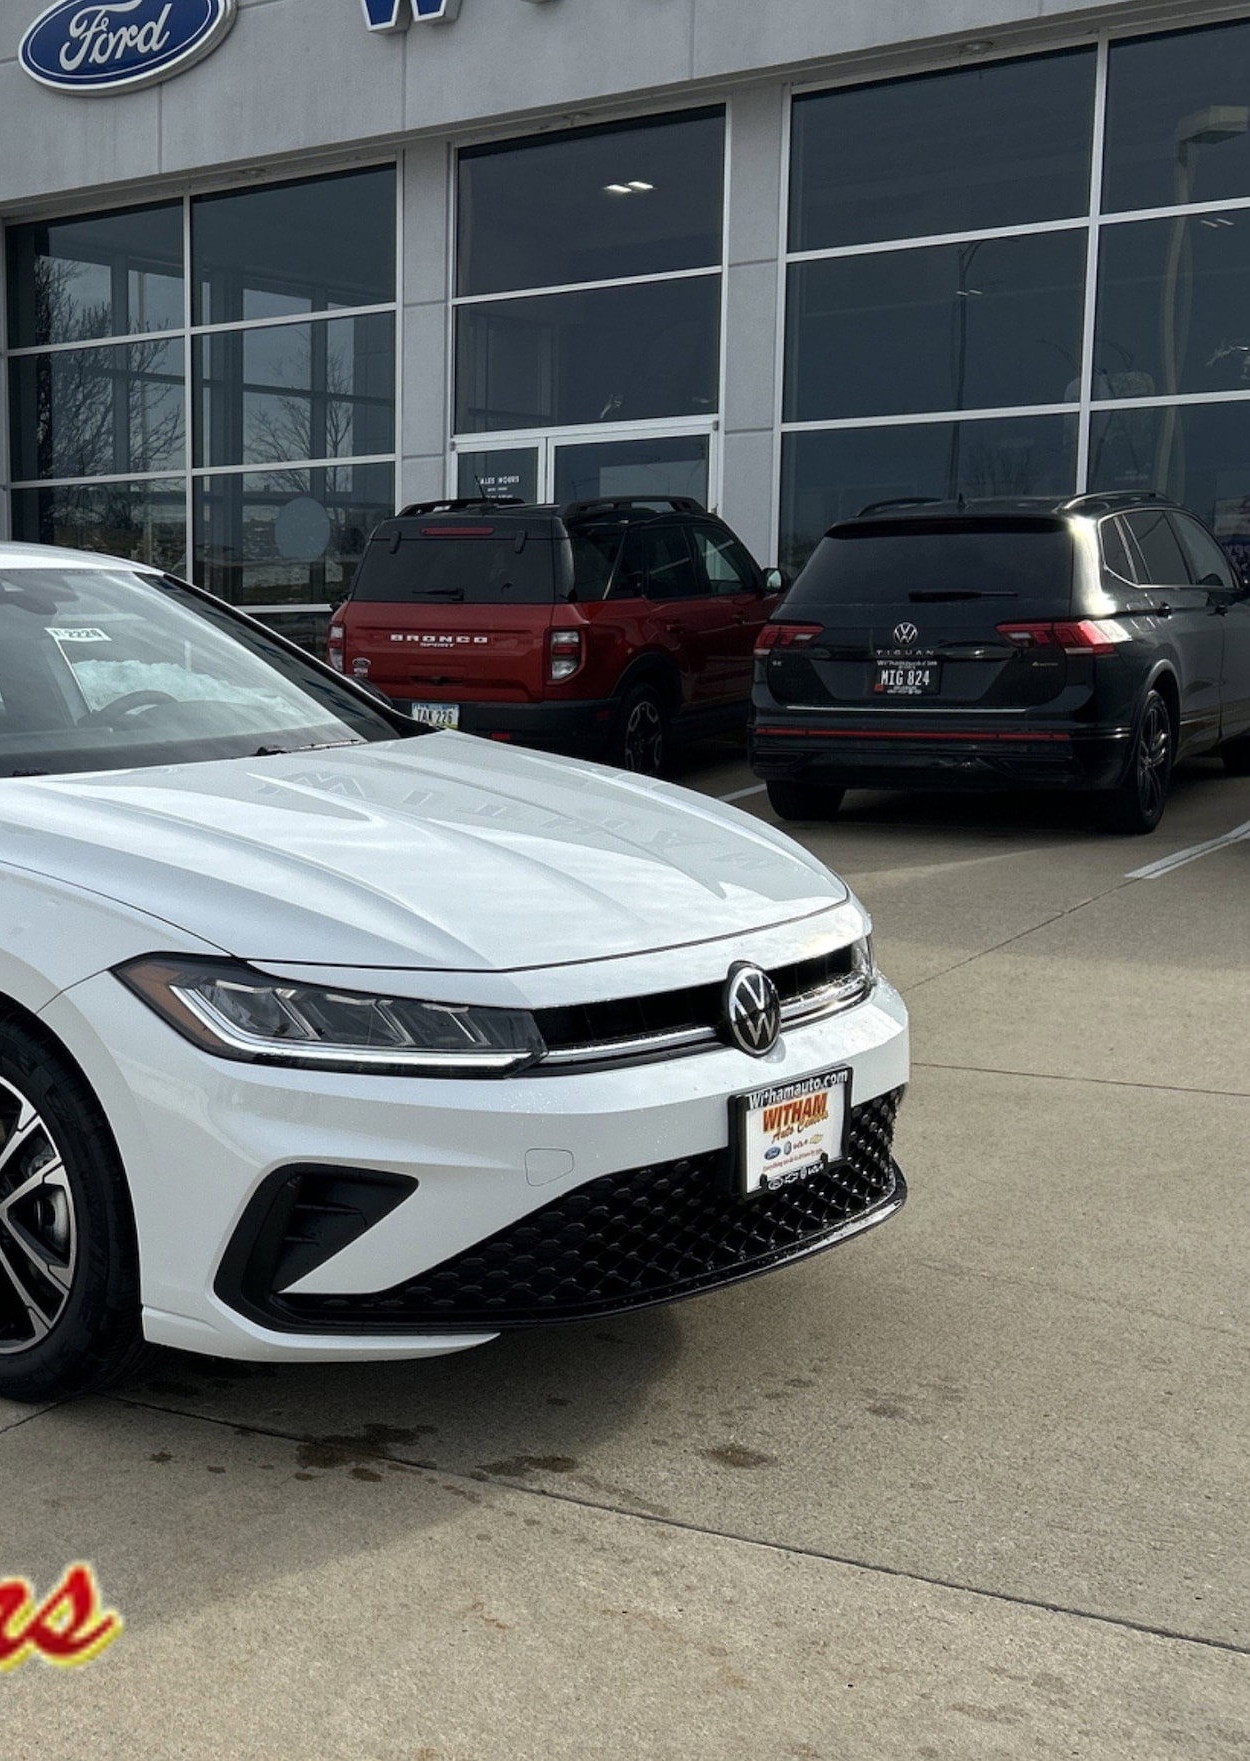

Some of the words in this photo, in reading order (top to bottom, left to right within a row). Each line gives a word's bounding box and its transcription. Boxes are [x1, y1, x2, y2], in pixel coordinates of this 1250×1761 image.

[59, 0, 172, 71] Ford
[390, 633, 488, 643] BRONCO
[906, 669, 930, 686] 824
[749, 1069, 848, 1110] Withamauto.com
[762, 1092, 829, 1133] WITHAM
